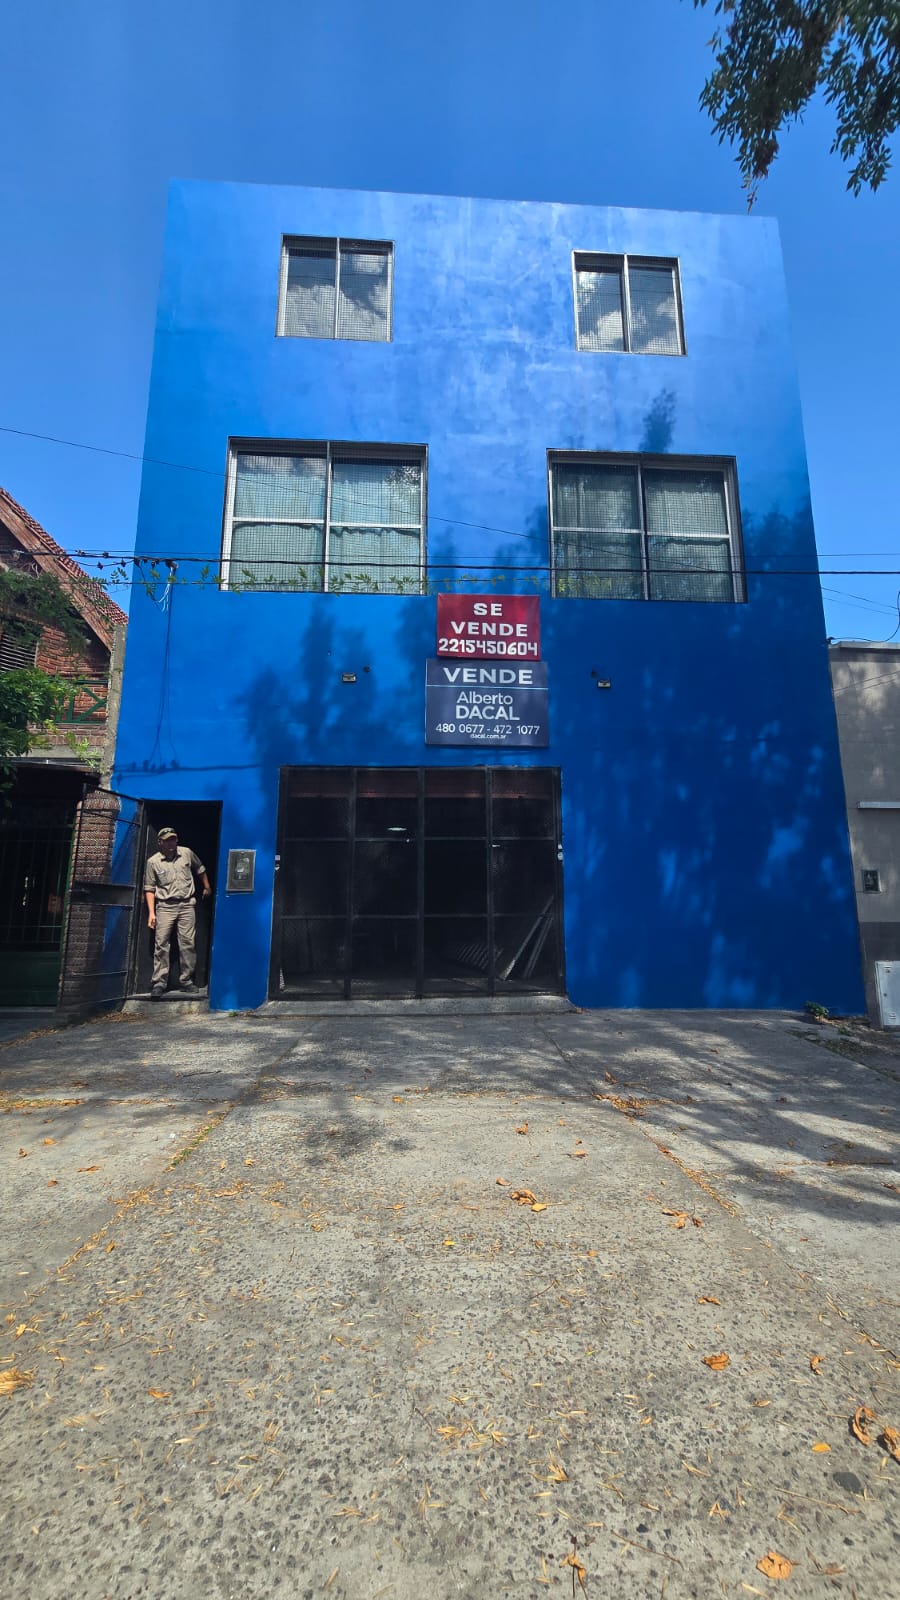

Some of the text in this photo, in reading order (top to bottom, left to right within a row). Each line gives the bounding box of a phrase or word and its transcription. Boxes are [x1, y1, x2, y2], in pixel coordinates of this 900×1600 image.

[473, 602, 503, 616] SE
[450, 621, 528, 637] VENDE
[438, 638, 538, 656] 2215450604
[443, 667, 533, 685] VENDE
[456, 691, 513, 705] Alberto
[455, 705, 520, 721] DACAL
[435, 723, 456, 733] 480
[458, 724, 485, 734] 0677
[493, 724, 512, 734] 472
[516, 725, 540, 735] 1077
